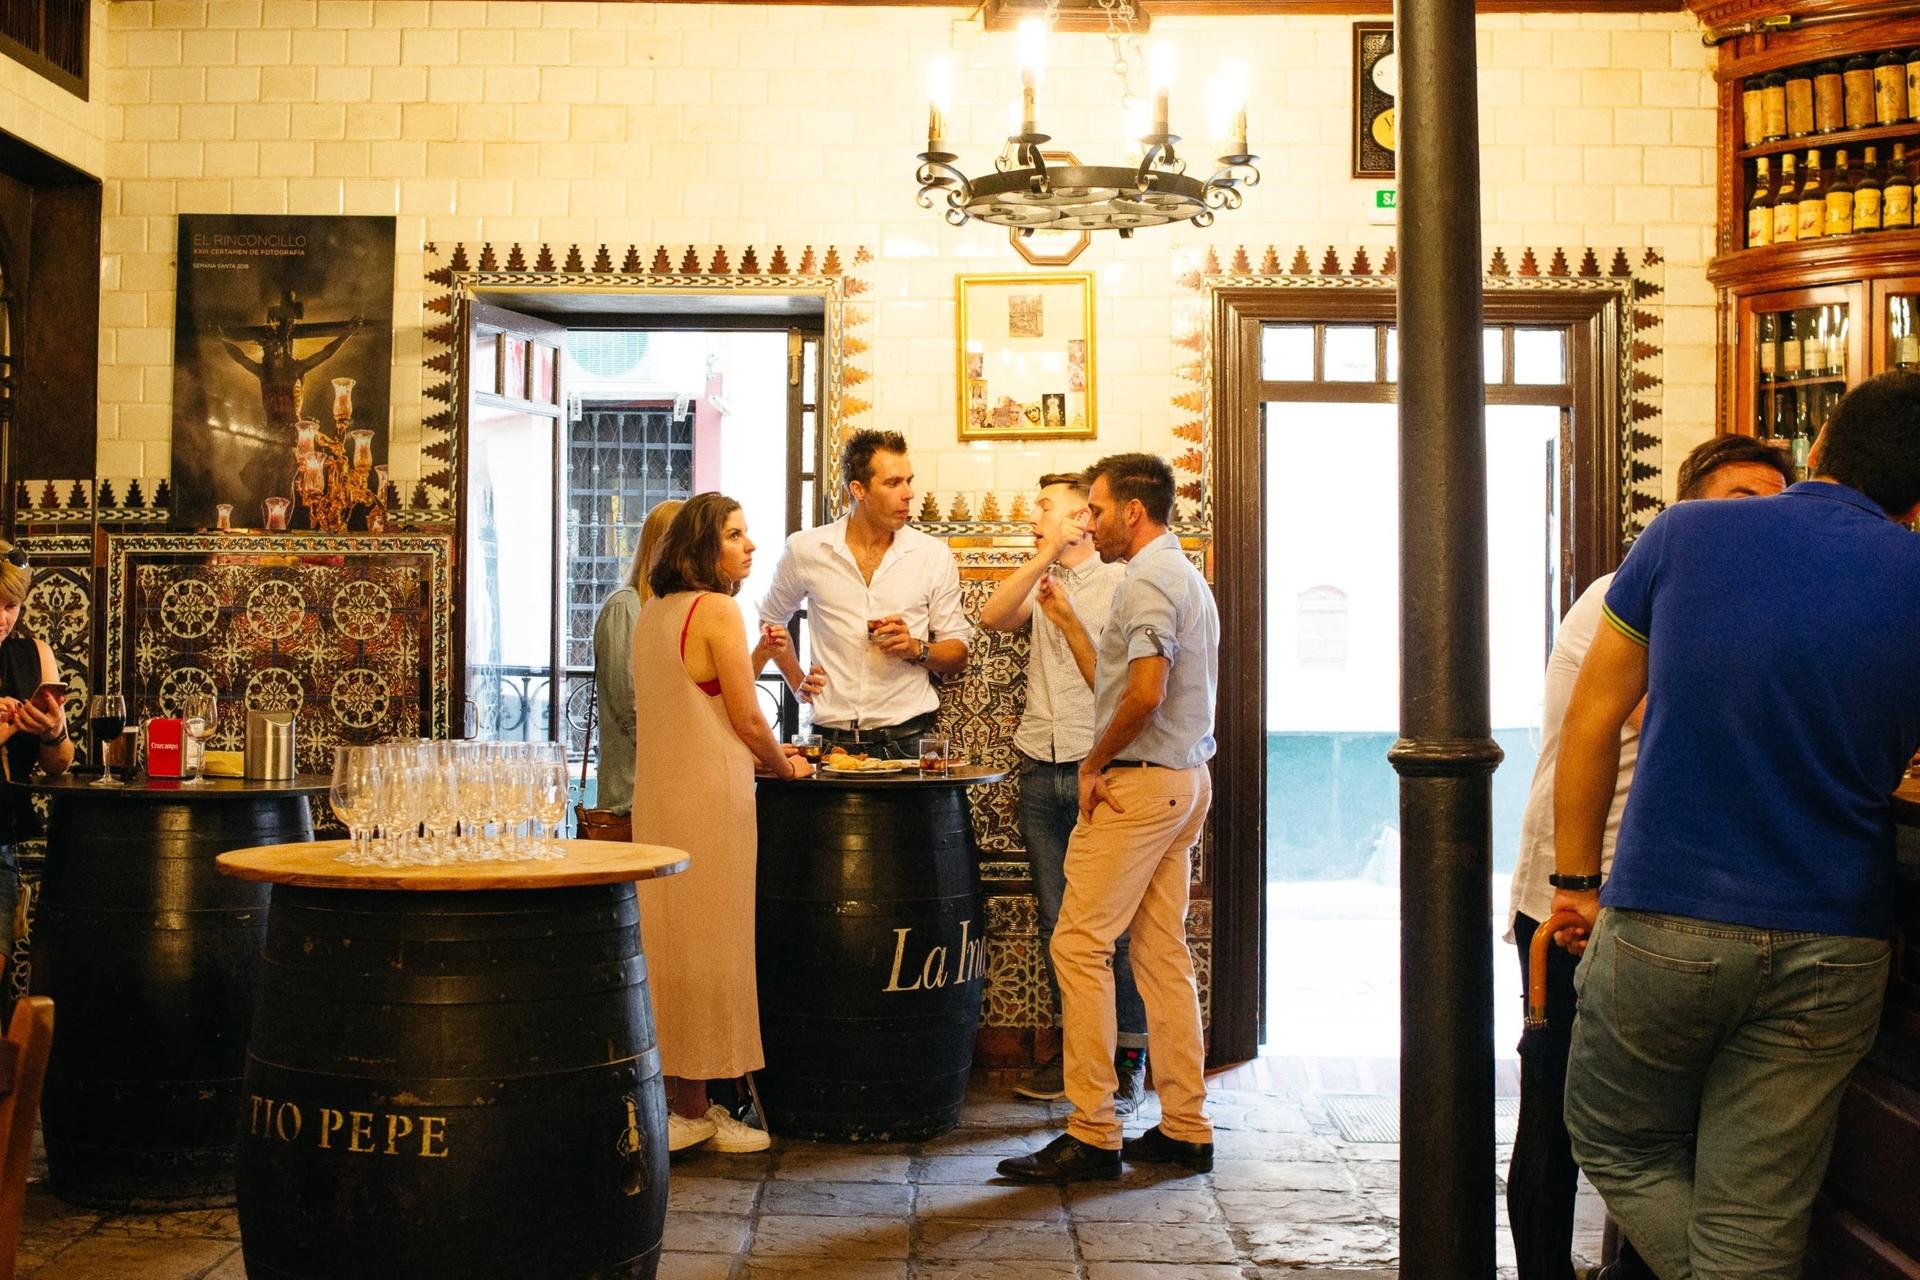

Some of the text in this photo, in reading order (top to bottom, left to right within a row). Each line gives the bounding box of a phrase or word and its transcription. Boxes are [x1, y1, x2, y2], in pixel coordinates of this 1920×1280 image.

[193, 233, 307, 247] EL RINCONCILLO
[210, 248, 248, 256] CERTAMEN
[882, 928, 948, 992] La
[251, 1095, 449, 1157] TIO PEPE
